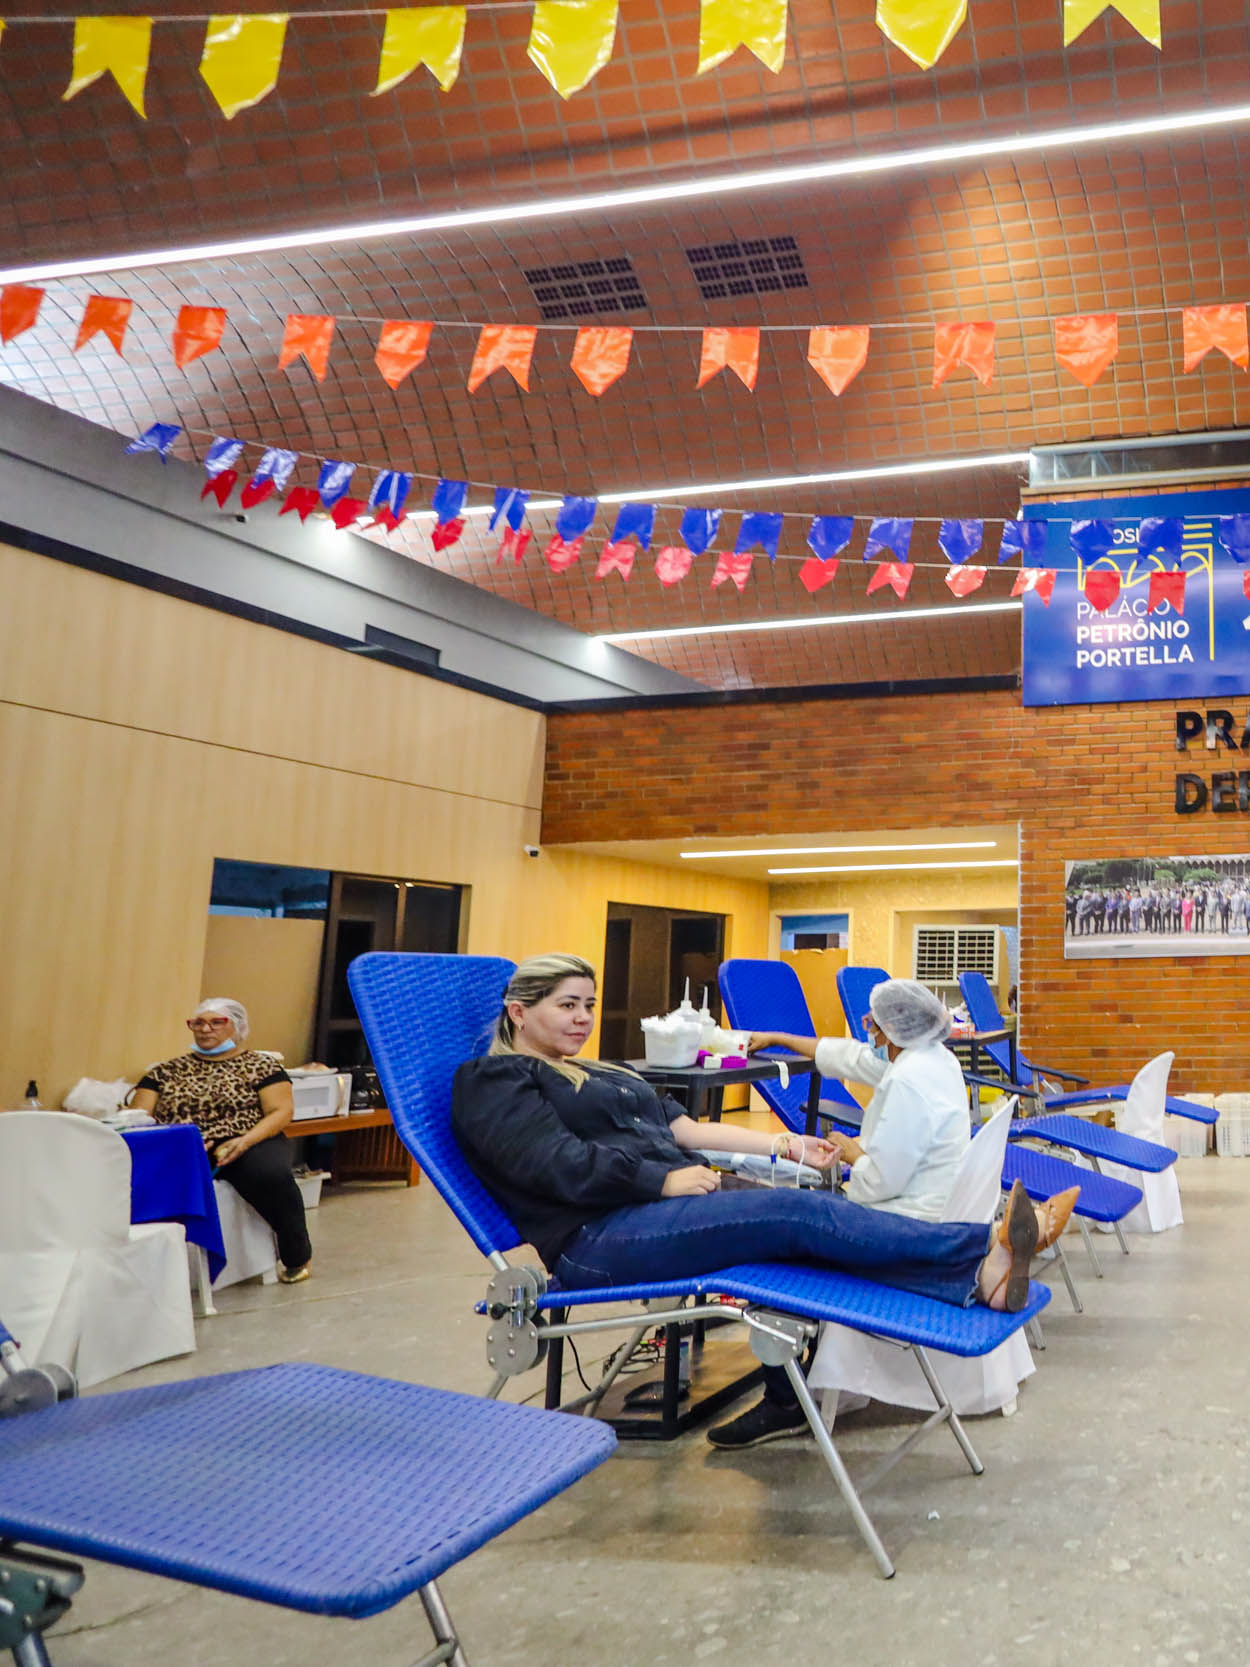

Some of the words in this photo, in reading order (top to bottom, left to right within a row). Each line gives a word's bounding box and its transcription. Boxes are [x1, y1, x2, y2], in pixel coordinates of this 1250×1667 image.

[1077, 595, 1171, 620] PALÁCO
[1077, 619, 1190, 645] PETRÔNIO
[1077, 644, 1195, 669] PORTELLA
